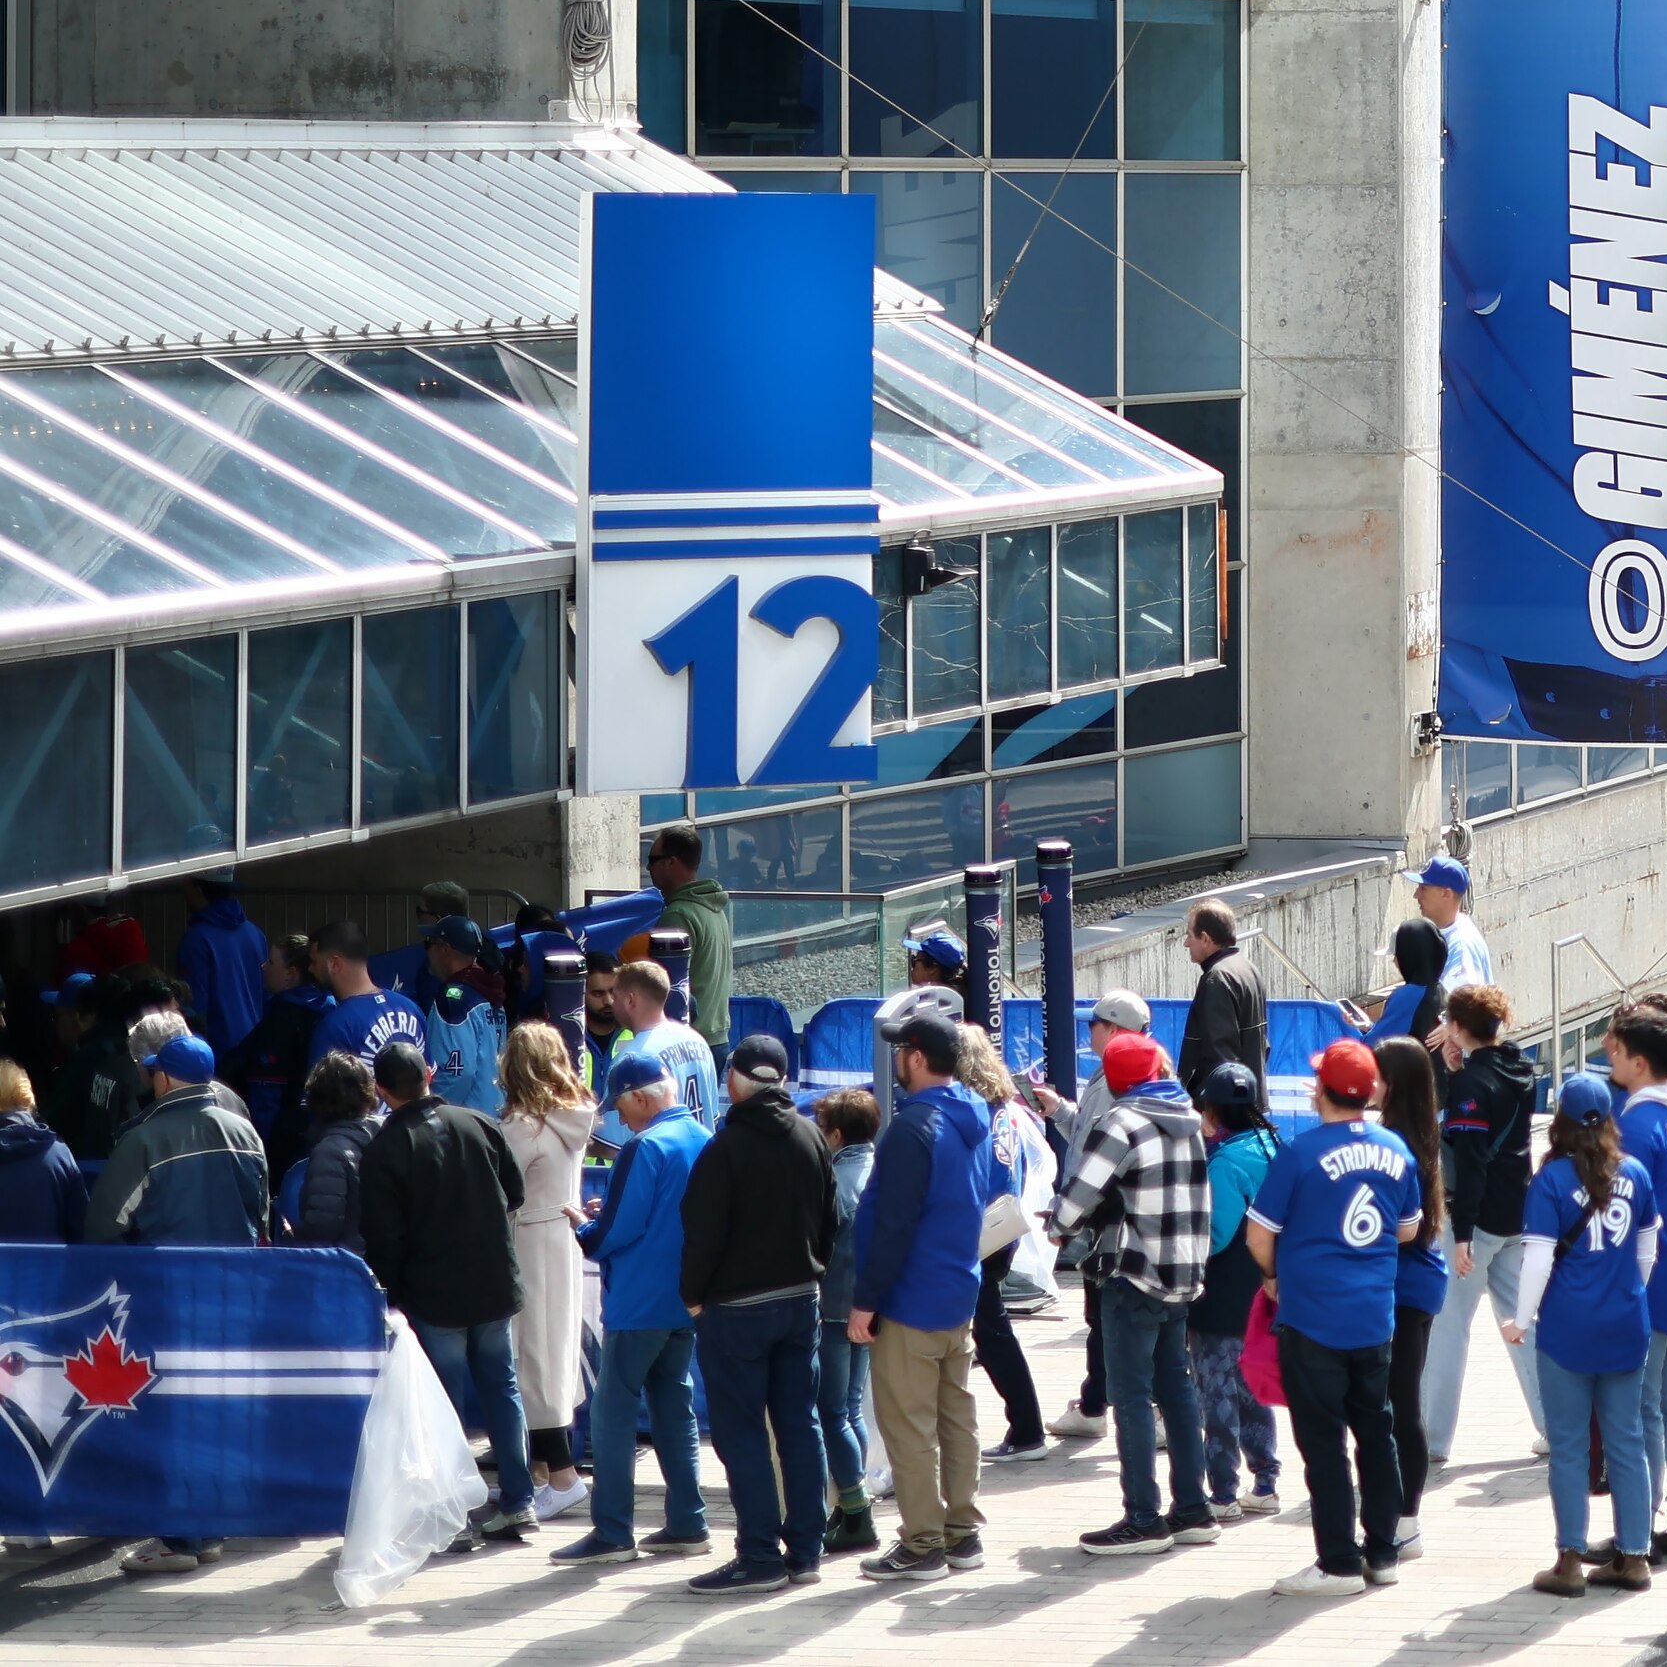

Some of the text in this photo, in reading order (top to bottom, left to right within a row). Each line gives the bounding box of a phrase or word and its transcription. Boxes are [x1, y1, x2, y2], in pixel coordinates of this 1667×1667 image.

[642, 573, 879, 790] 12
[987, 945, 1001, 1029] TORONTO
[446, 1049, 465, 1076] 4
[1320, 1142, 1406, 1182] STROMAN
[1343, 1184, 1383, 1247] 6
[1586, 1197, 1632, 1252] 19
[112, 1411, 126, 1419] TM
